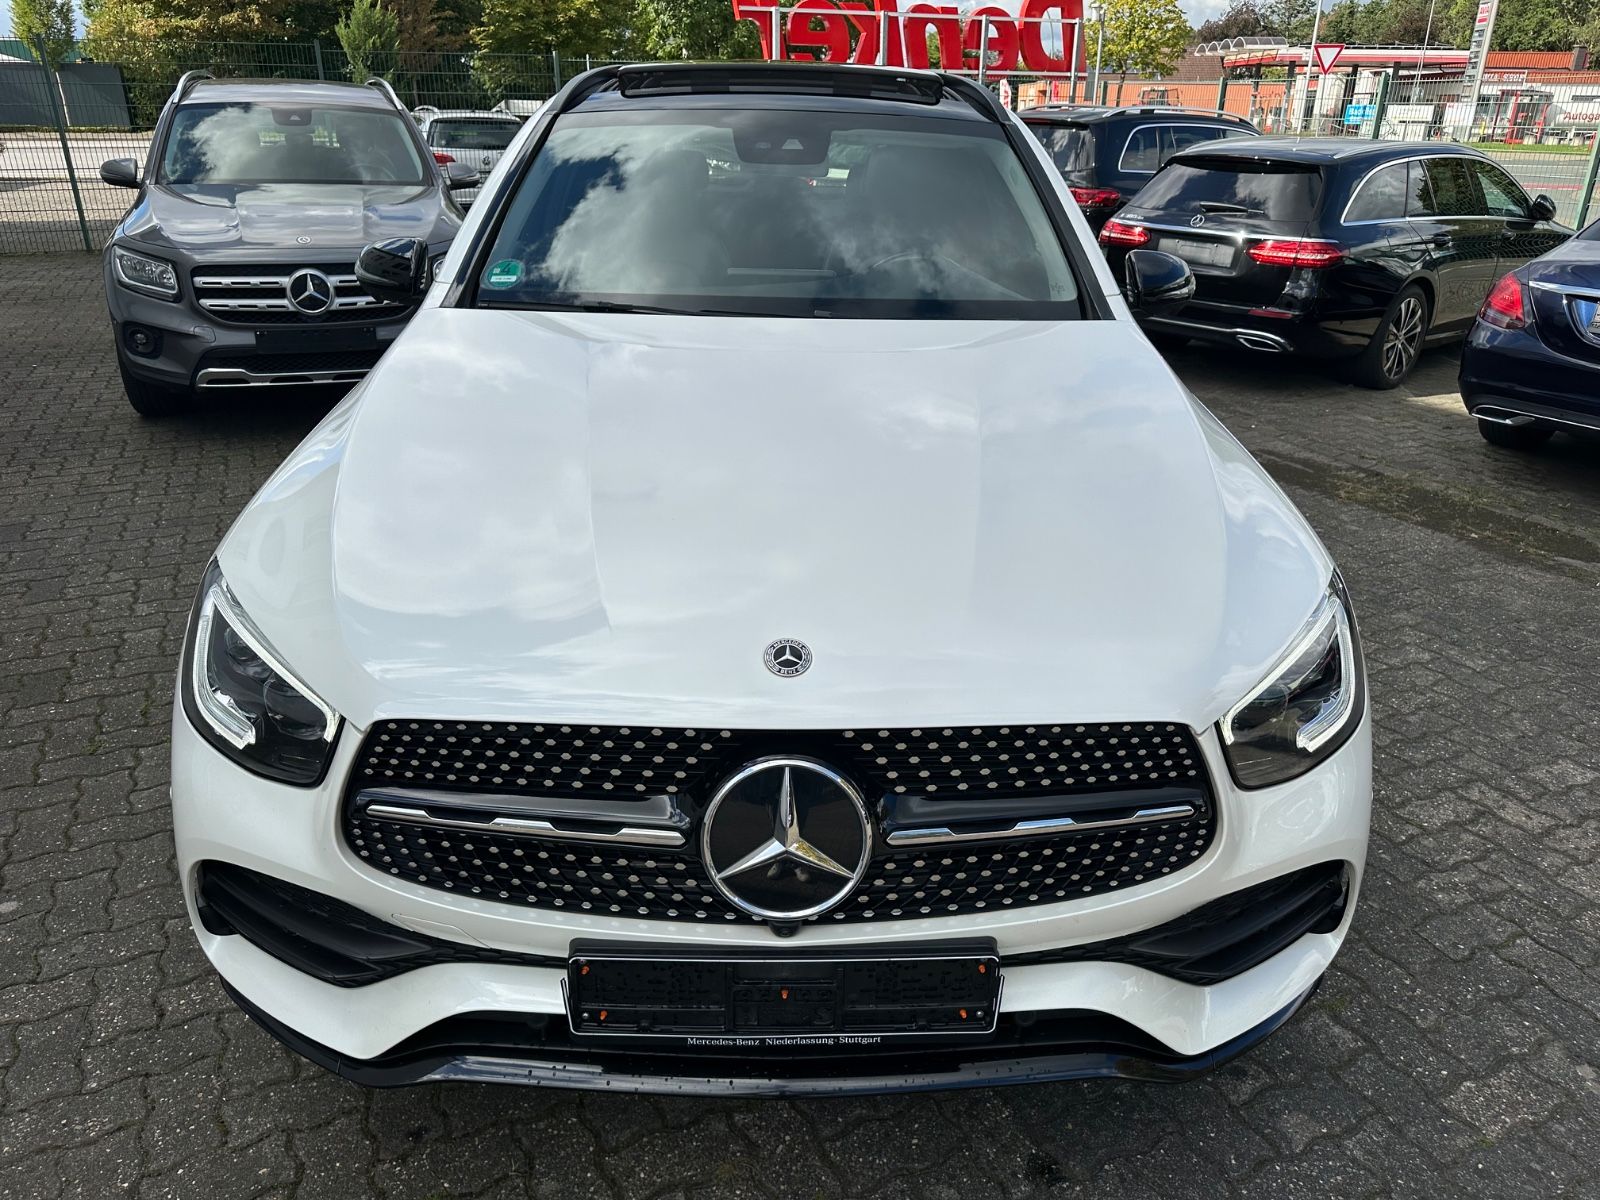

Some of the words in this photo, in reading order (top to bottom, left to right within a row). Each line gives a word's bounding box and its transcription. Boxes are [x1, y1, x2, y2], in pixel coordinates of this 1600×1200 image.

[687, 1037, 760, 1046] Mercedes-Benz
[765, 1037, 834, 1045] Niederlassung
[838, 1036, 881, 1045] Stuttgart
